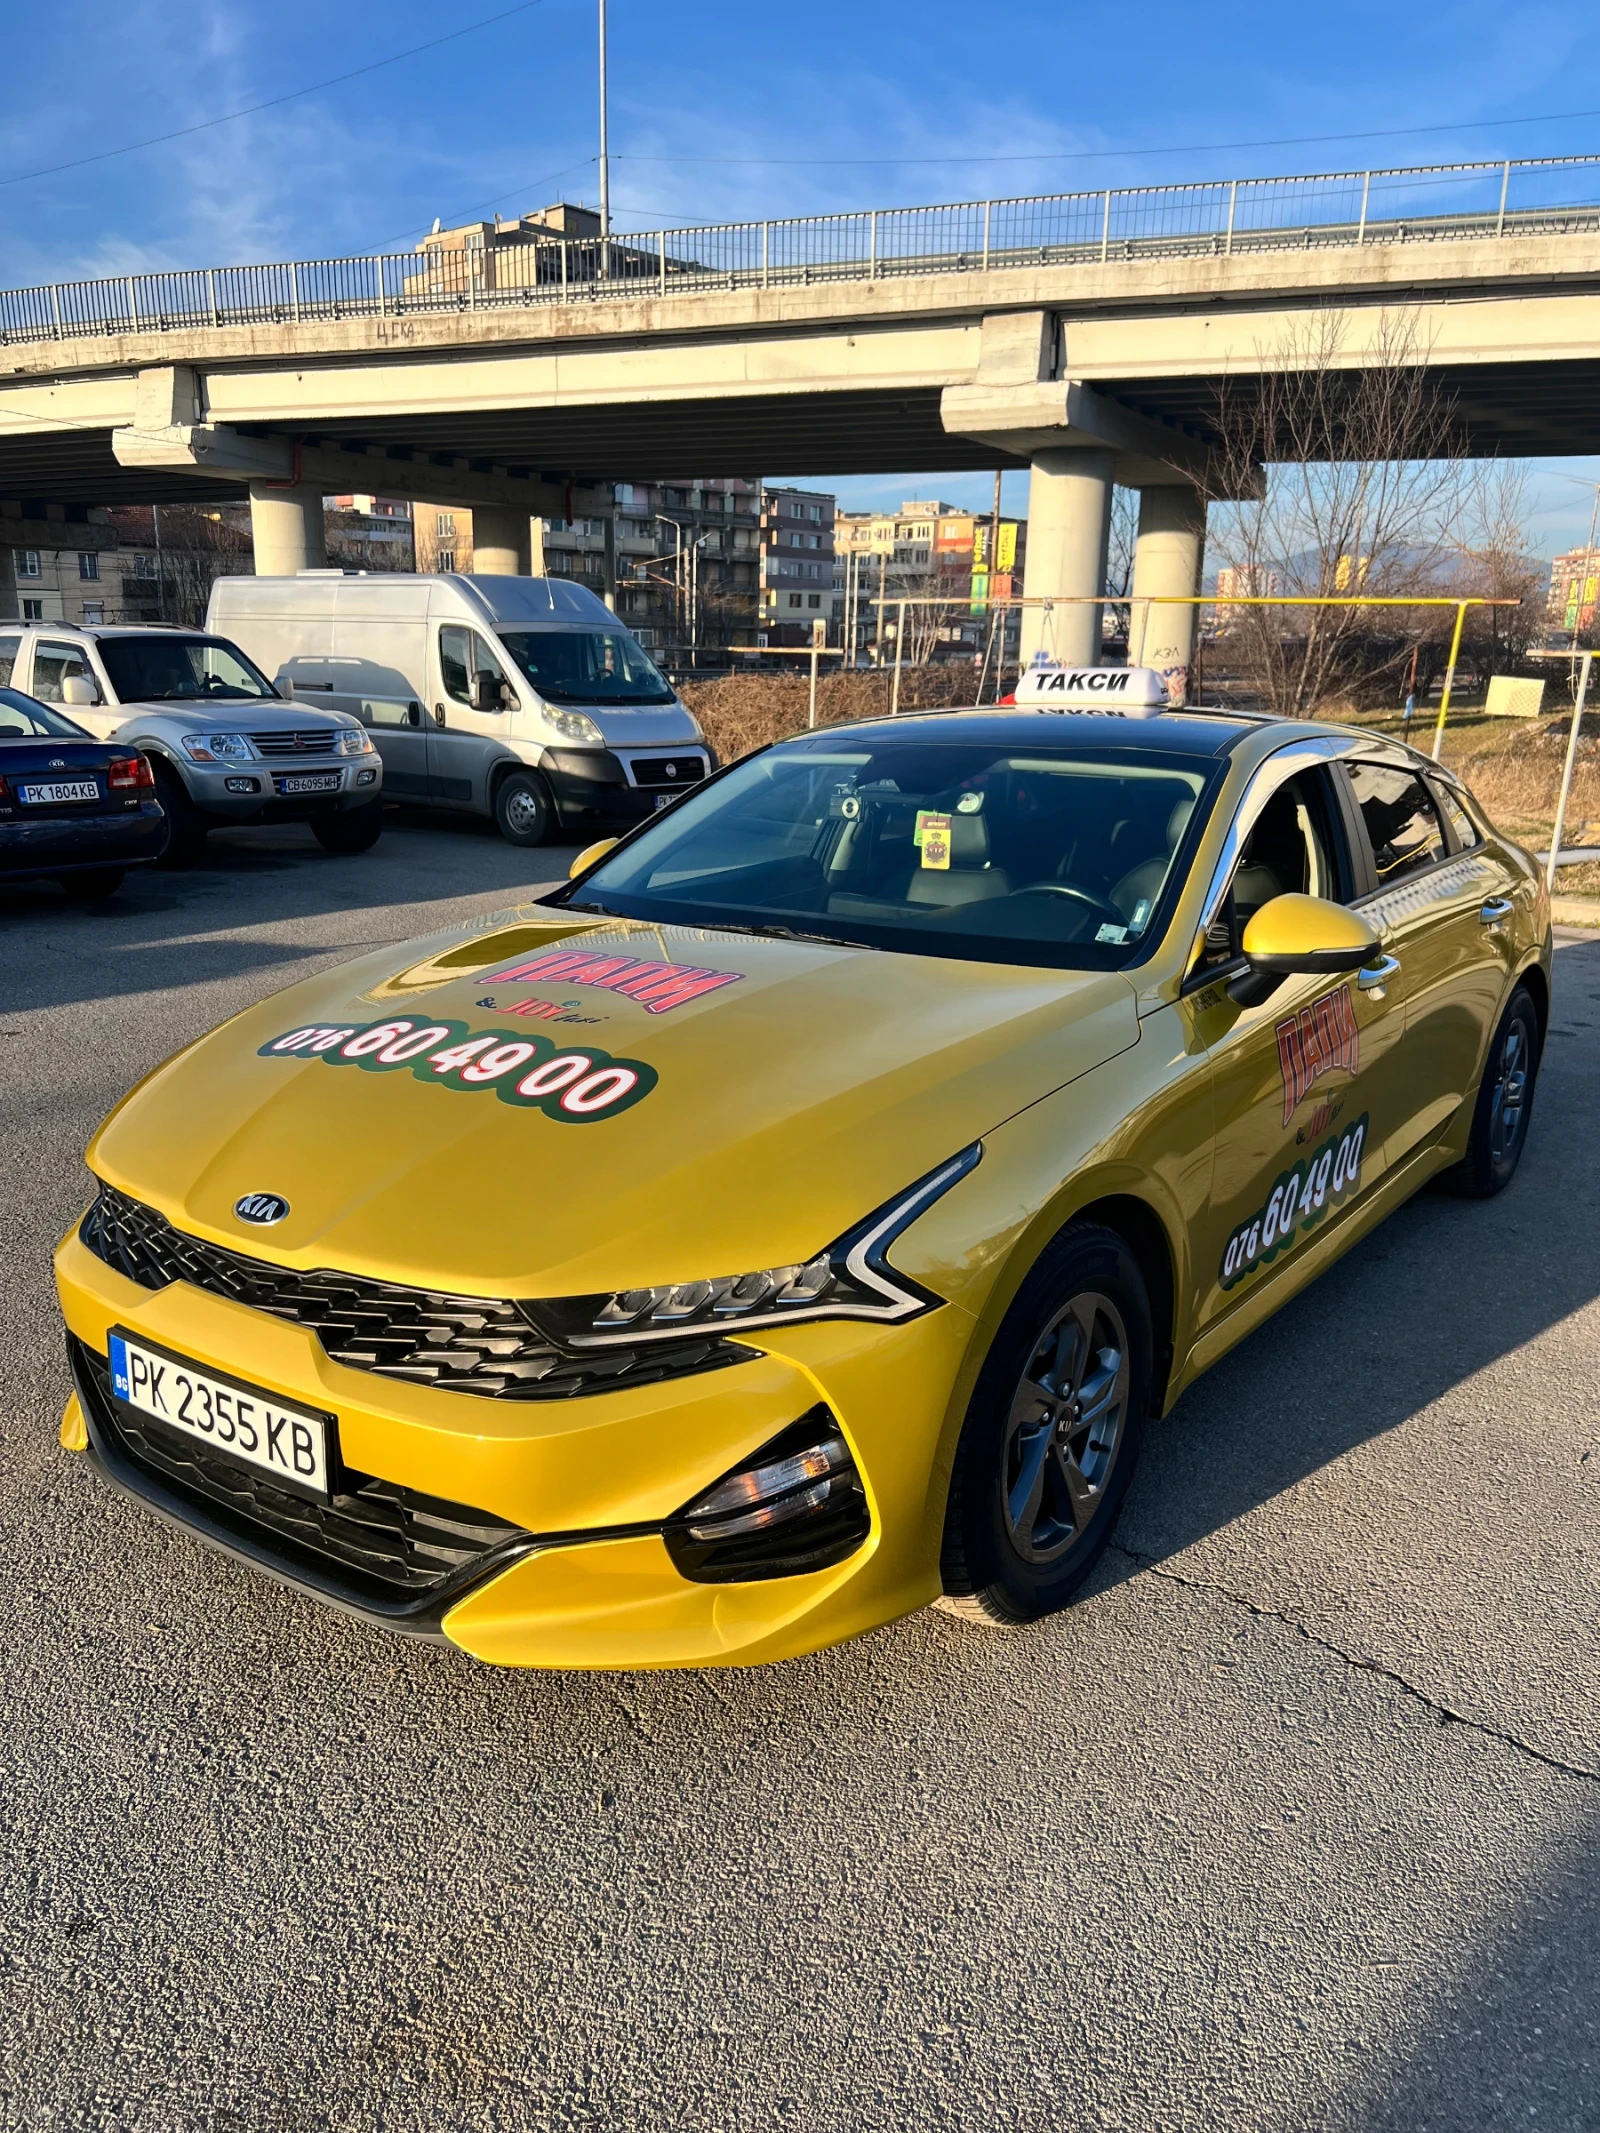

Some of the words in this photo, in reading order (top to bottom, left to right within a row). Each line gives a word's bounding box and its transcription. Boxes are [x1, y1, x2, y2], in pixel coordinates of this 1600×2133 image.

[1036, 673, 1130, 691] ТАКСИ
[27, 787, 46, 801] PK
[48, 785, 78, 799] 1804
[79, 784, 97, 797] KB
[288, 780, 300, 791] CB
[301, 778, 322, 790] 6095
[475, 950, 746, 1015] ПАПИ
[495, 997, 572, 1020] JOY
[272, 1027, 356, 1052] 076
[341, 1021, 452, 1064] 60
[427, 1035, 537, 1083] 49
[515, 1055, 639, 1114] 00
[1275, 983, 1359, 1129] ПАПИ
[238, 1195, 279, 1221] KIA
[1223, 1219, 1261, 1277] 076
[1262, 1172, 1300, 1247] 60
[1298, 1147, 1333, 1216] 49
[1332, 1123, 1365, 1192] 00
[115, 1373, 129, 1392] BG
[130, 1351, 170, 1415] PK
[175, 1375, 259, 1452] 2355
[265, 1411, 317, 1477] KB
